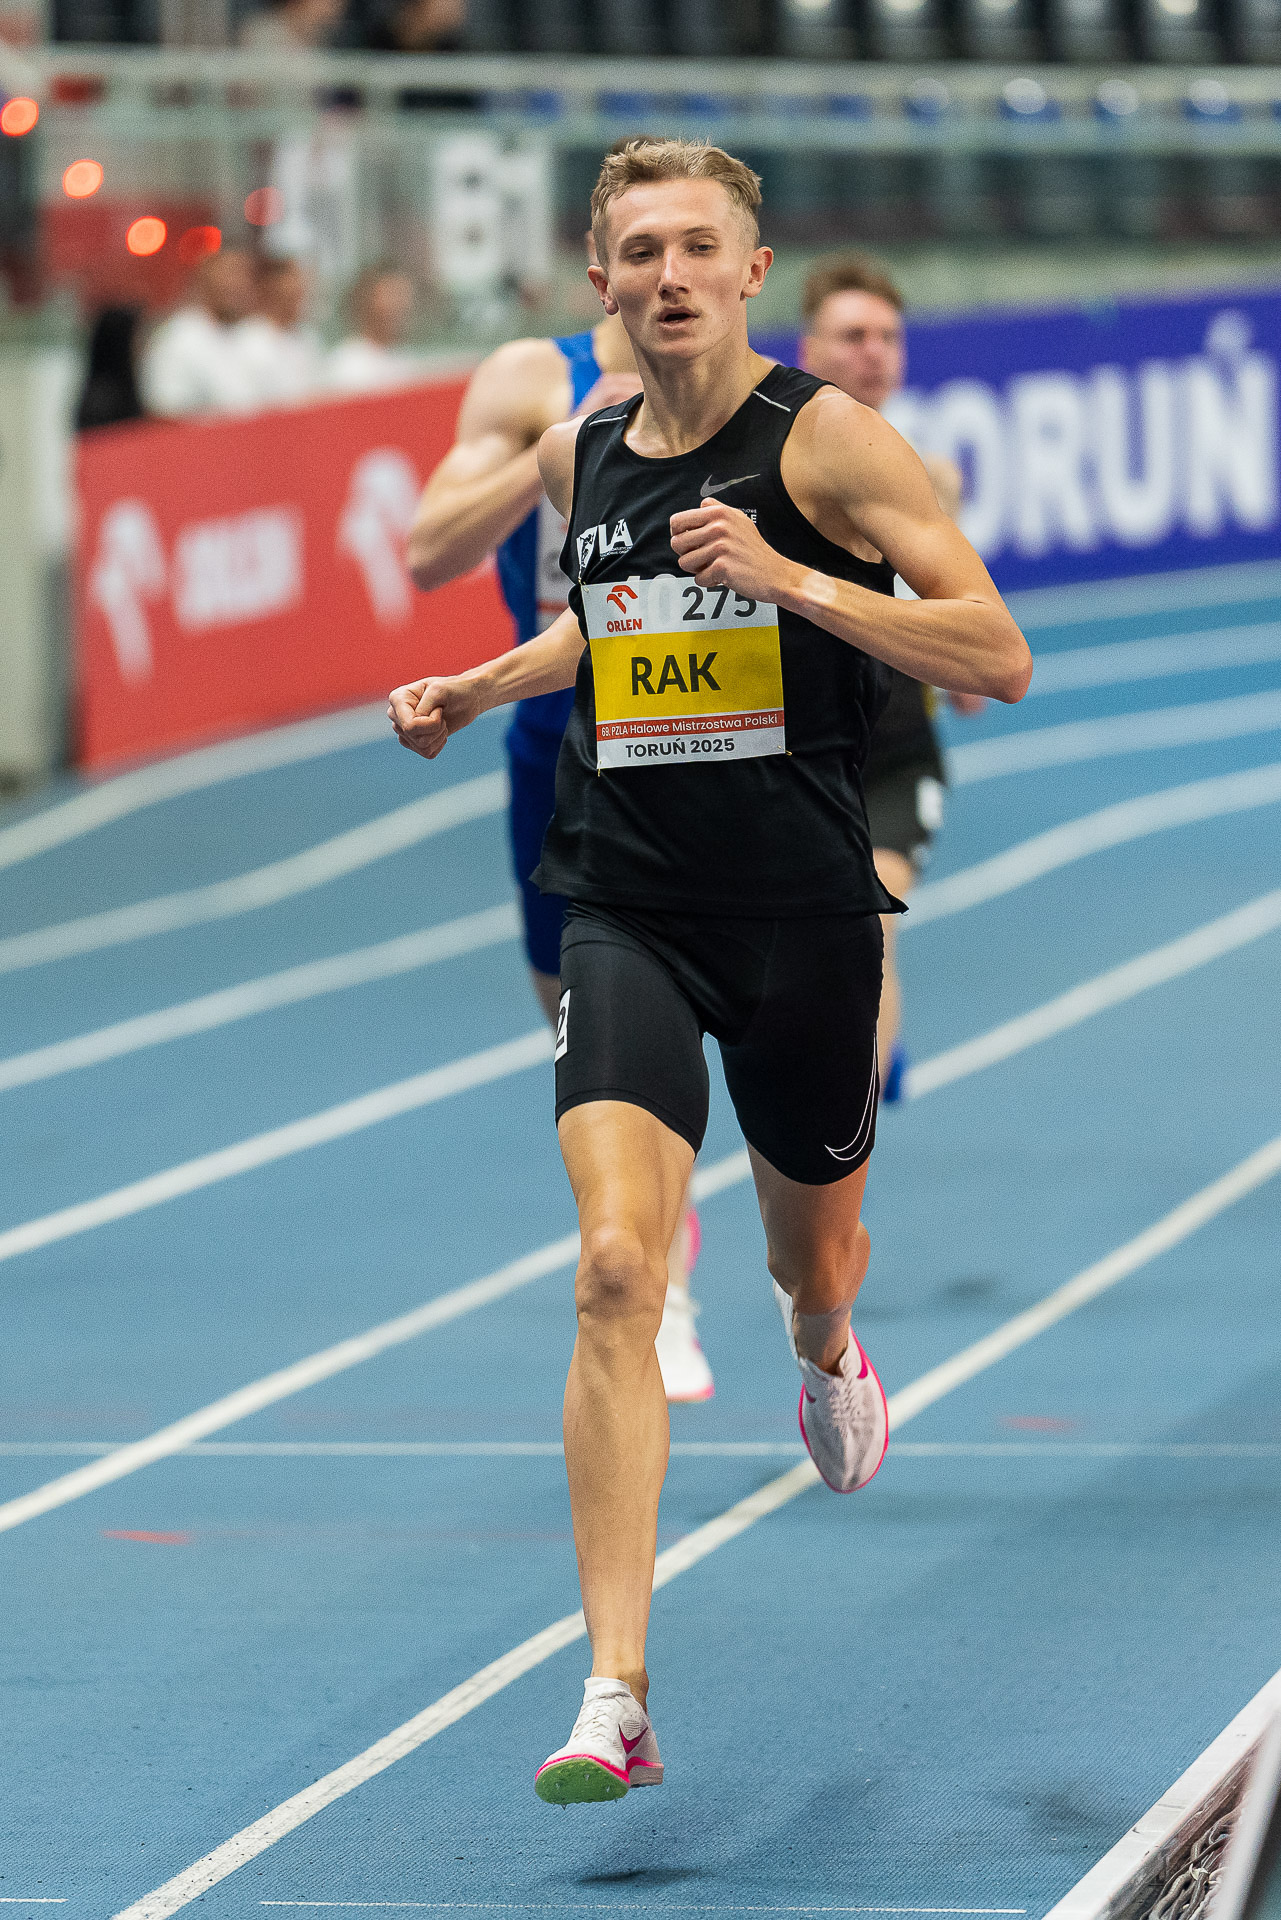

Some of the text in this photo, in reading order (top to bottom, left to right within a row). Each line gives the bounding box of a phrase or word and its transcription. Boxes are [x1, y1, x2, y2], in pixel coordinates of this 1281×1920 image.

[884, 314, 1275, 554] ORUŃ
[682, 585, 757, 621] 275
[606, 618, 643, 633] ORLEN
[631, 651, 722, 696] RAK
[611, 725, 629, 736] PZLA
[630, 722, 670, 734] Halowe
[672, 718, 742, 732] Mistrzostwa
[745, 713, 778, 727] Polski
[625, 737, 735, 758] TORUŃ 2025
